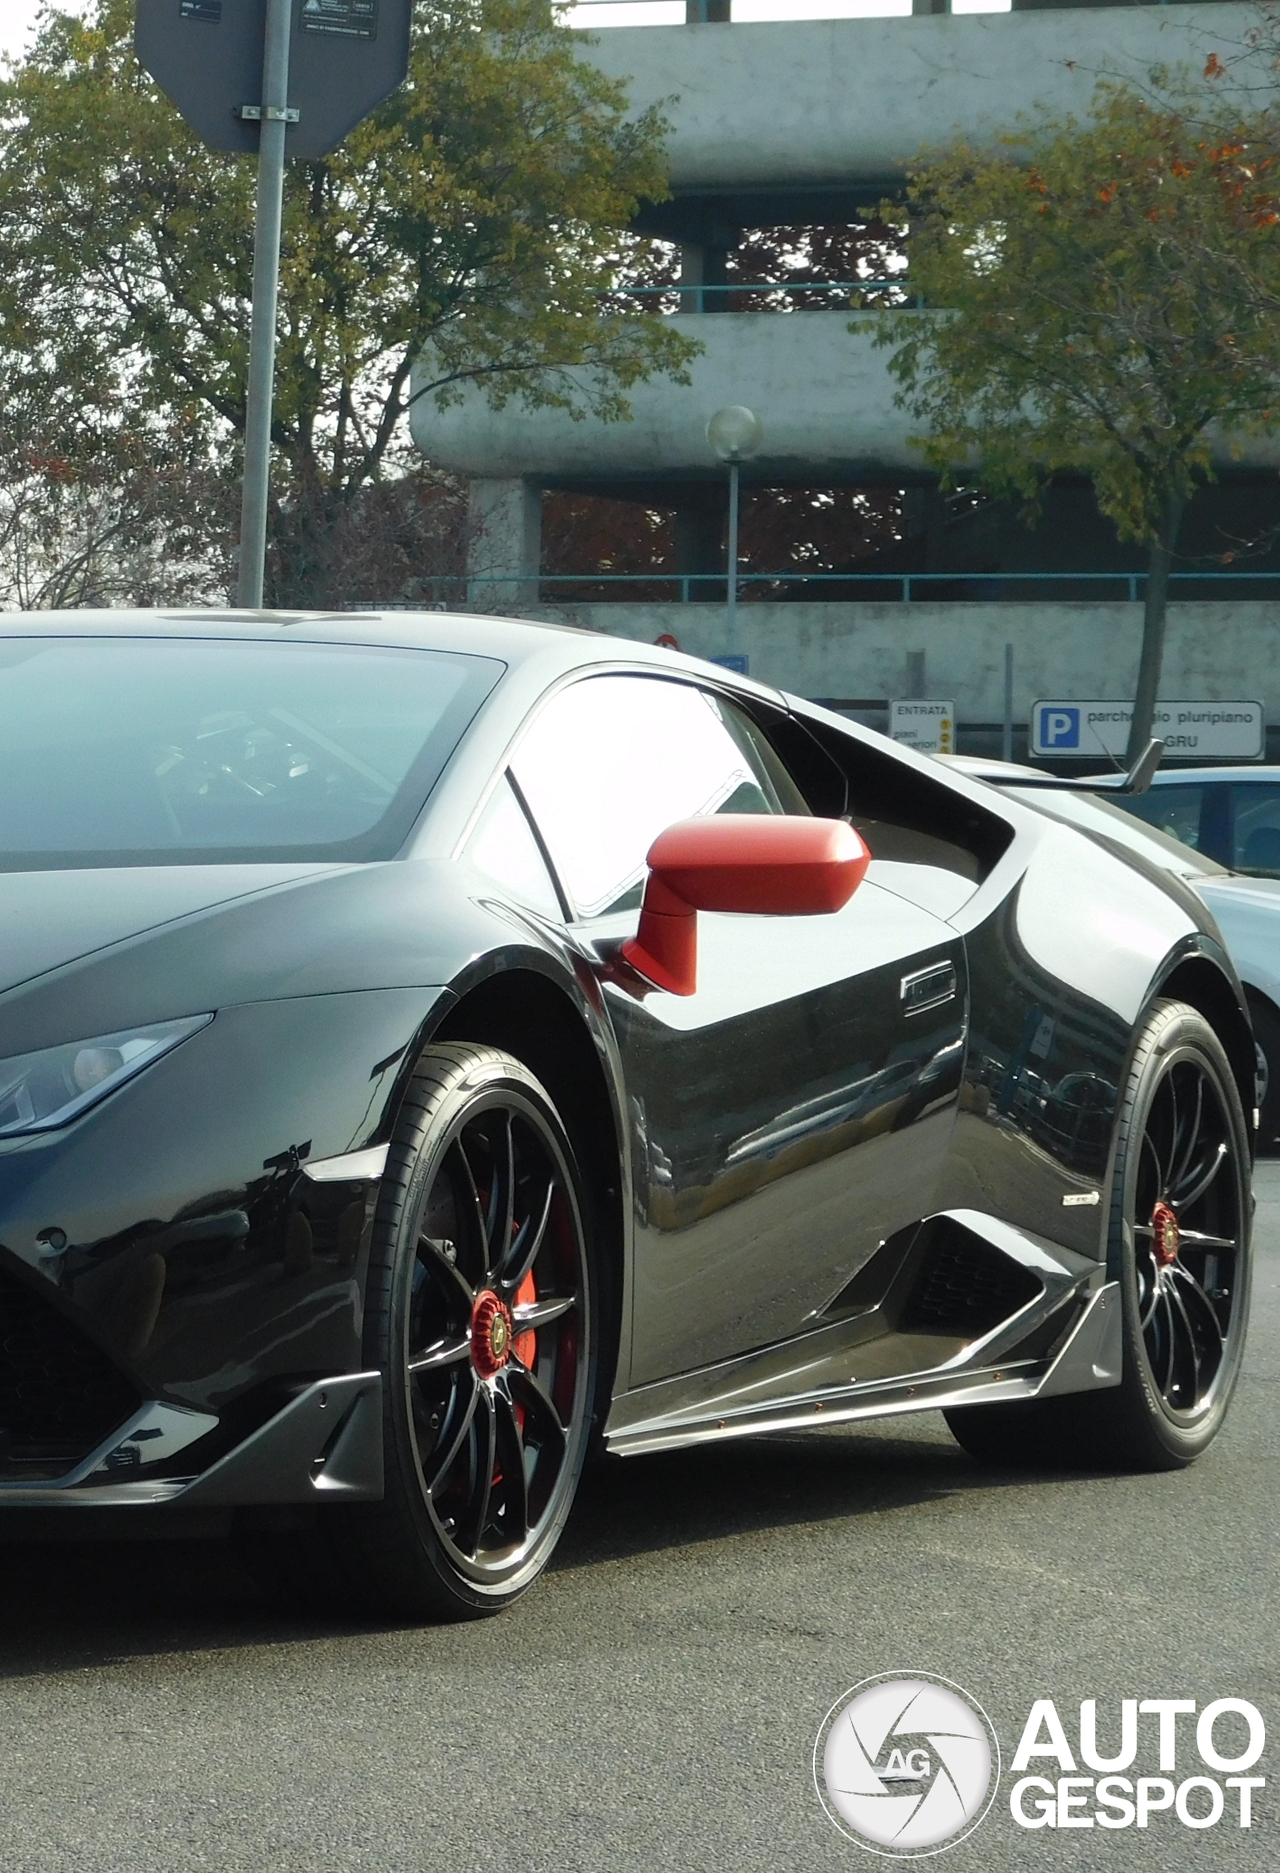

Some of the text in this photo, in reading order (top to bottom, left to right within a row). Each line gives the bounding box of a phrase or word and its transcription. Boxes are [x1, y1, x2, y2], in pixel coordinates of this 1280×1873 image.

[898, 706, 949, 716] ENTRATA
[1178, 710, 1253, 724] pluripiano
[1165, 735, 1198, 747] GRU
